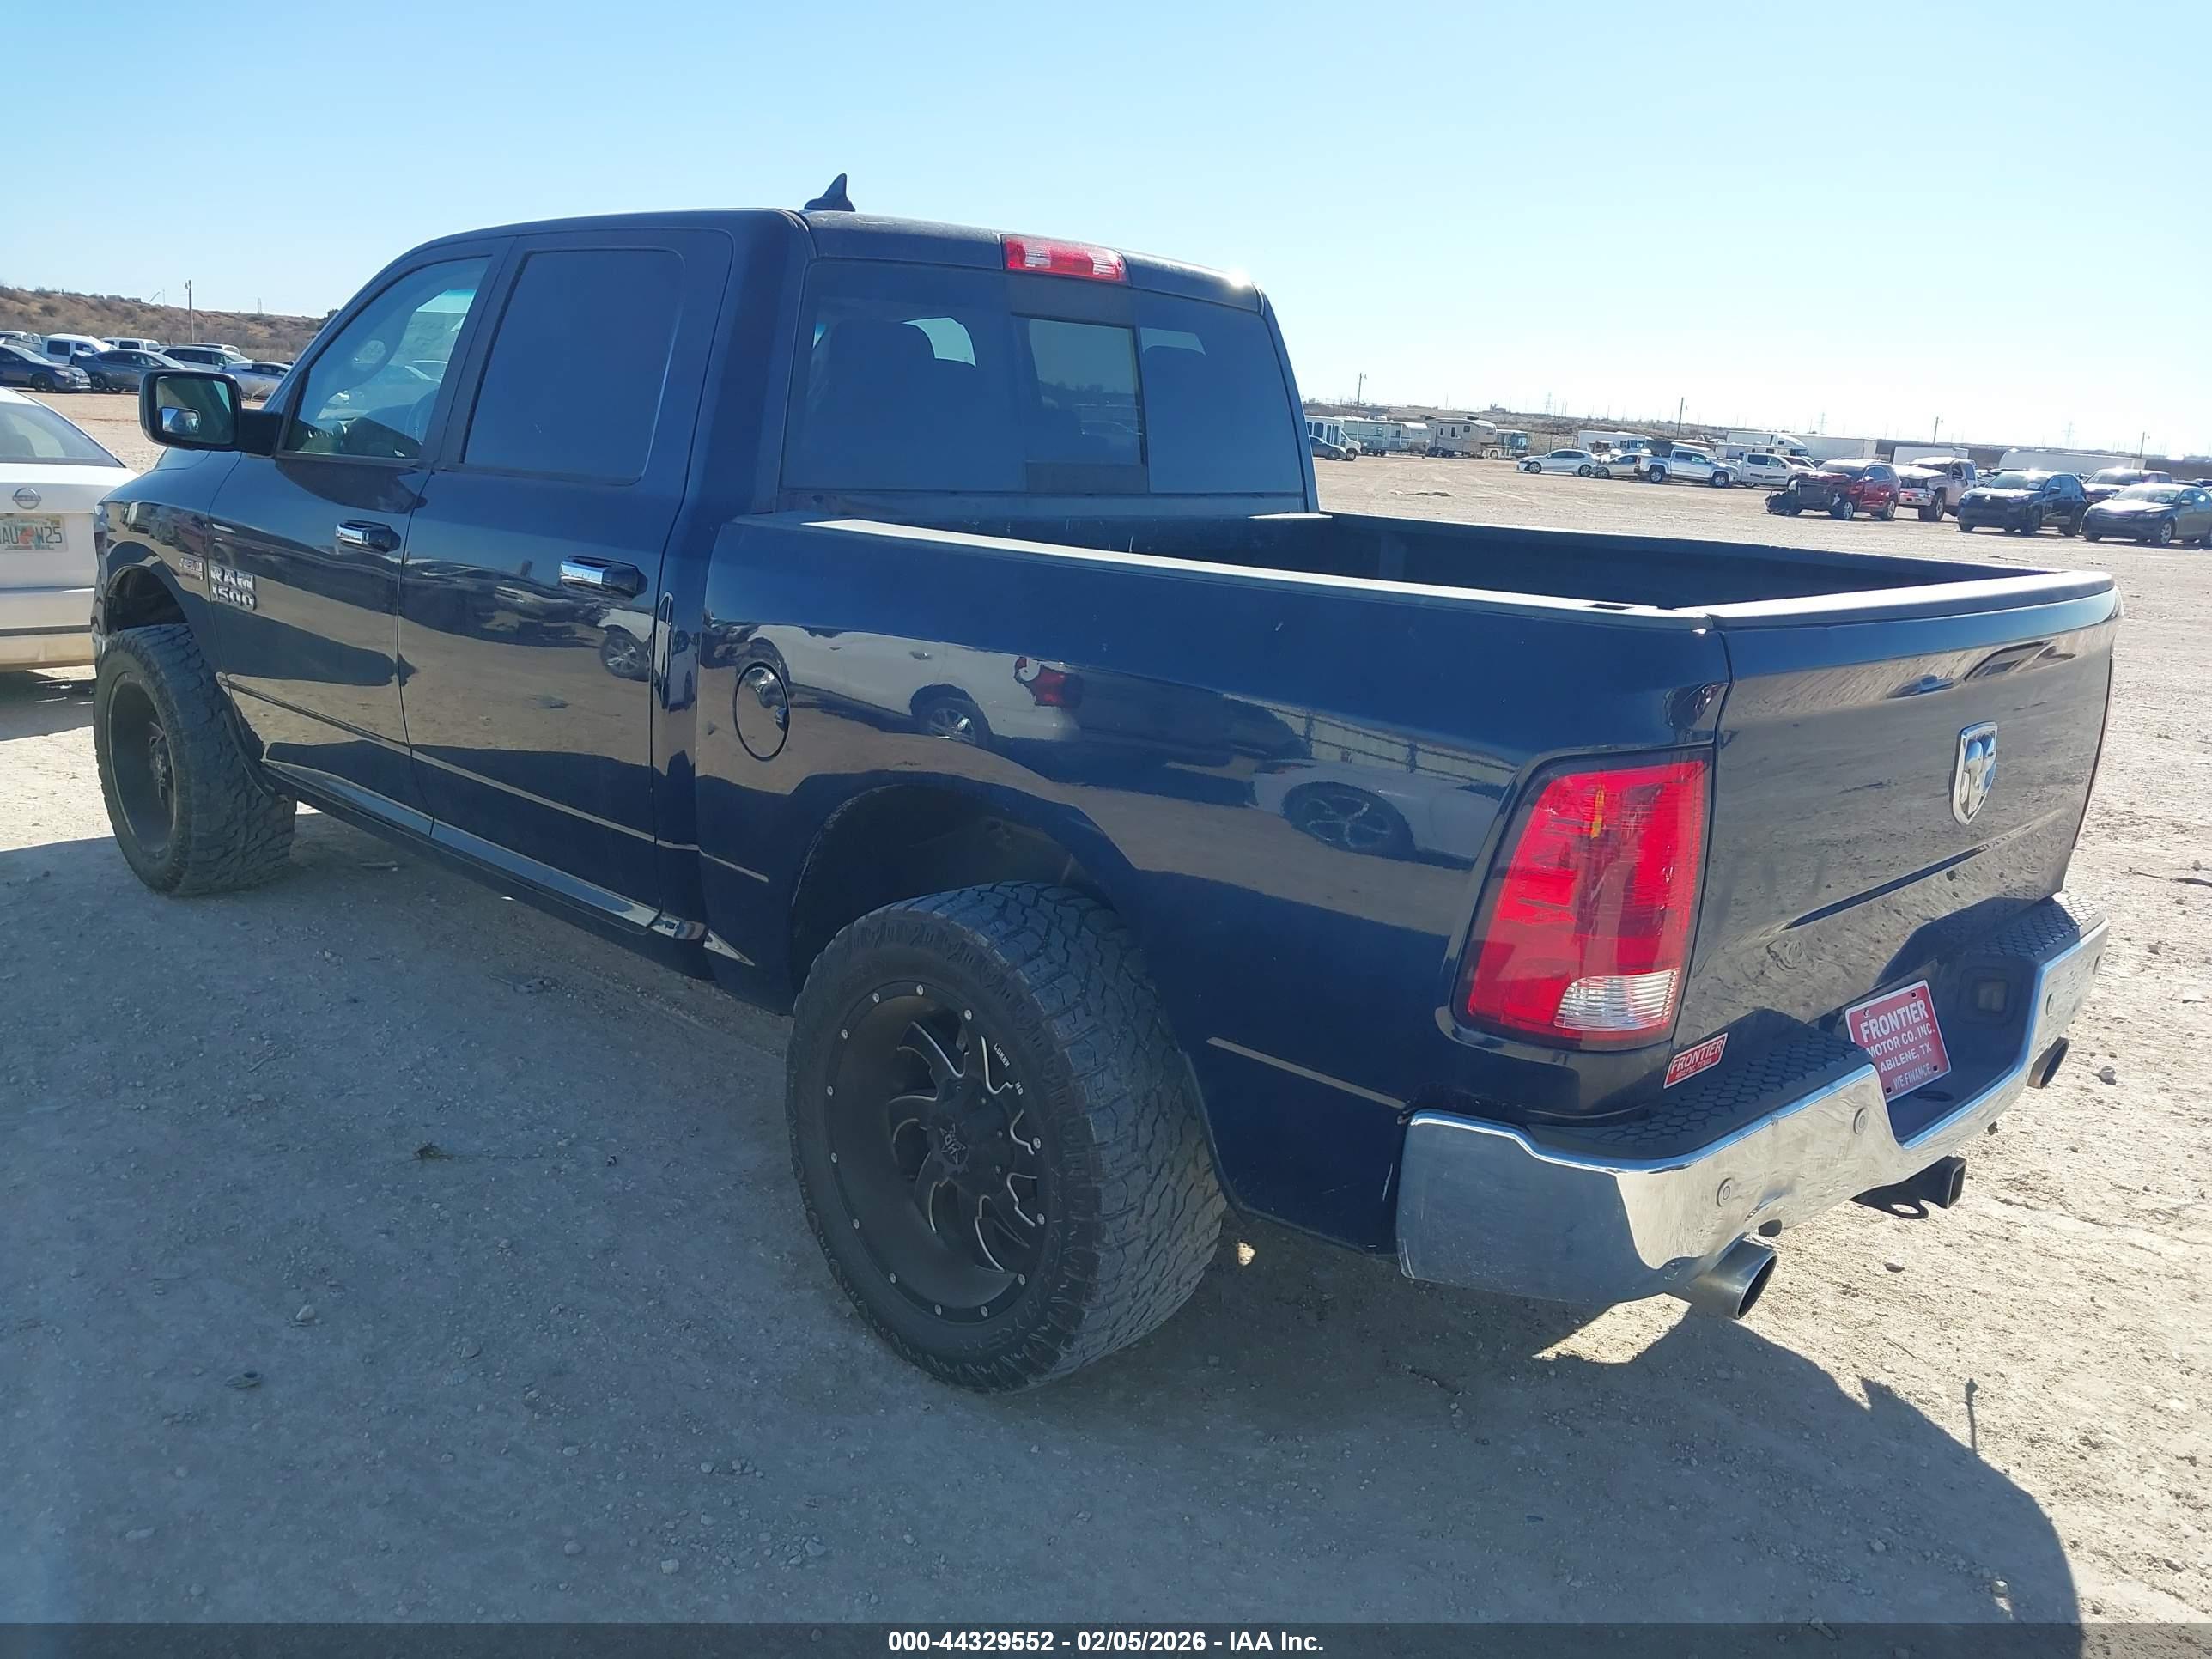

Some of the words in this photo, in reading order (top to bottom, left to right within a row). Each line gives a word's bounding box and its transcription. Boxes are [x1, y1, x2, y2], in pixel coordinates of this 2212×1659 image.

[210, 564, 254, 592] RAM
[212, 583, 256, 611] 1500
[1860, 1000, 1929, 1043] FRONTIER
[1867, 1037, 1901, 1059] MOTOR
[1901, 1030, 1917, 1045] CO.
[1917, 1022, 1936, 1039] INC.
[1670, 1039, 1723, 1074] FRONTIER
[1881, 1048, 1920, 1073] ABILENE,
[1919, 1042, 1932, 1056] TX
[1892, 1075, 1905, 1090] WE
[1905, 1062, 1931, 1085] FINANCE
